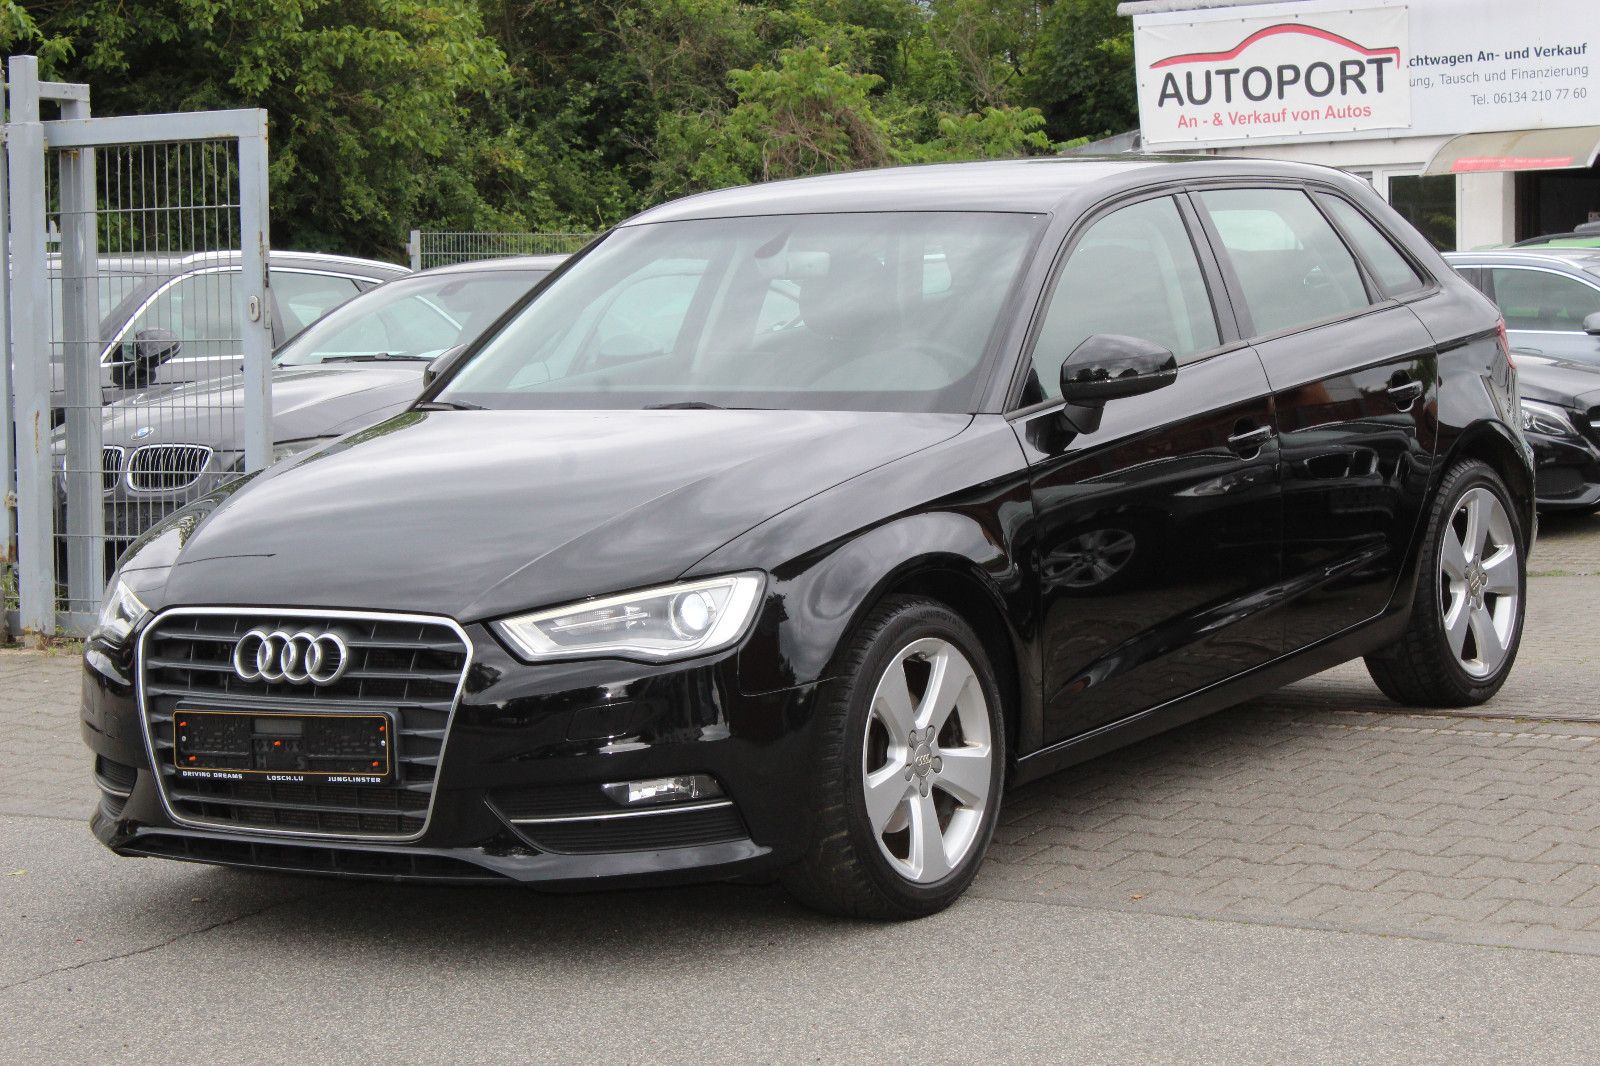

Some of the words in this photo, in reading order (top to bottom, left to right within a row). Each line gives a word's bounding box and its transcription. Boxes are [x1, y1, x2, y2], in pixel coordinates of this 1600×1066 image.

[1477, 51, 1500, 63] An-
[1504, 47, 1530, 60] und
[1534, 43, 1588, 57] Verkauf
[1157, 56, 1394, 108] AUTOPORT
[1439, 71, 1479, 85] Tausch
[1484, 69, 1506, 82] und
[1511, 65, 1589, 80] Finanzierung
[1471, 93, 1490, 106] Tel.
[1493, 91, 1527, 104] 06134
[1531, 89, 1552, 101] 210
[1556, 88, 1570, 100] 77
[1573, 87, 1588, 99] 60
[1177, 113, 1198, 129] An
[1212, 112, 1224, 127] &
[1227, 107, 1287, 126] Verkauf
[1291, 108, 1320, 122] von
[1324, 104, 1372, 120] Autos
[182, 770, 211, 778] DRIVING
